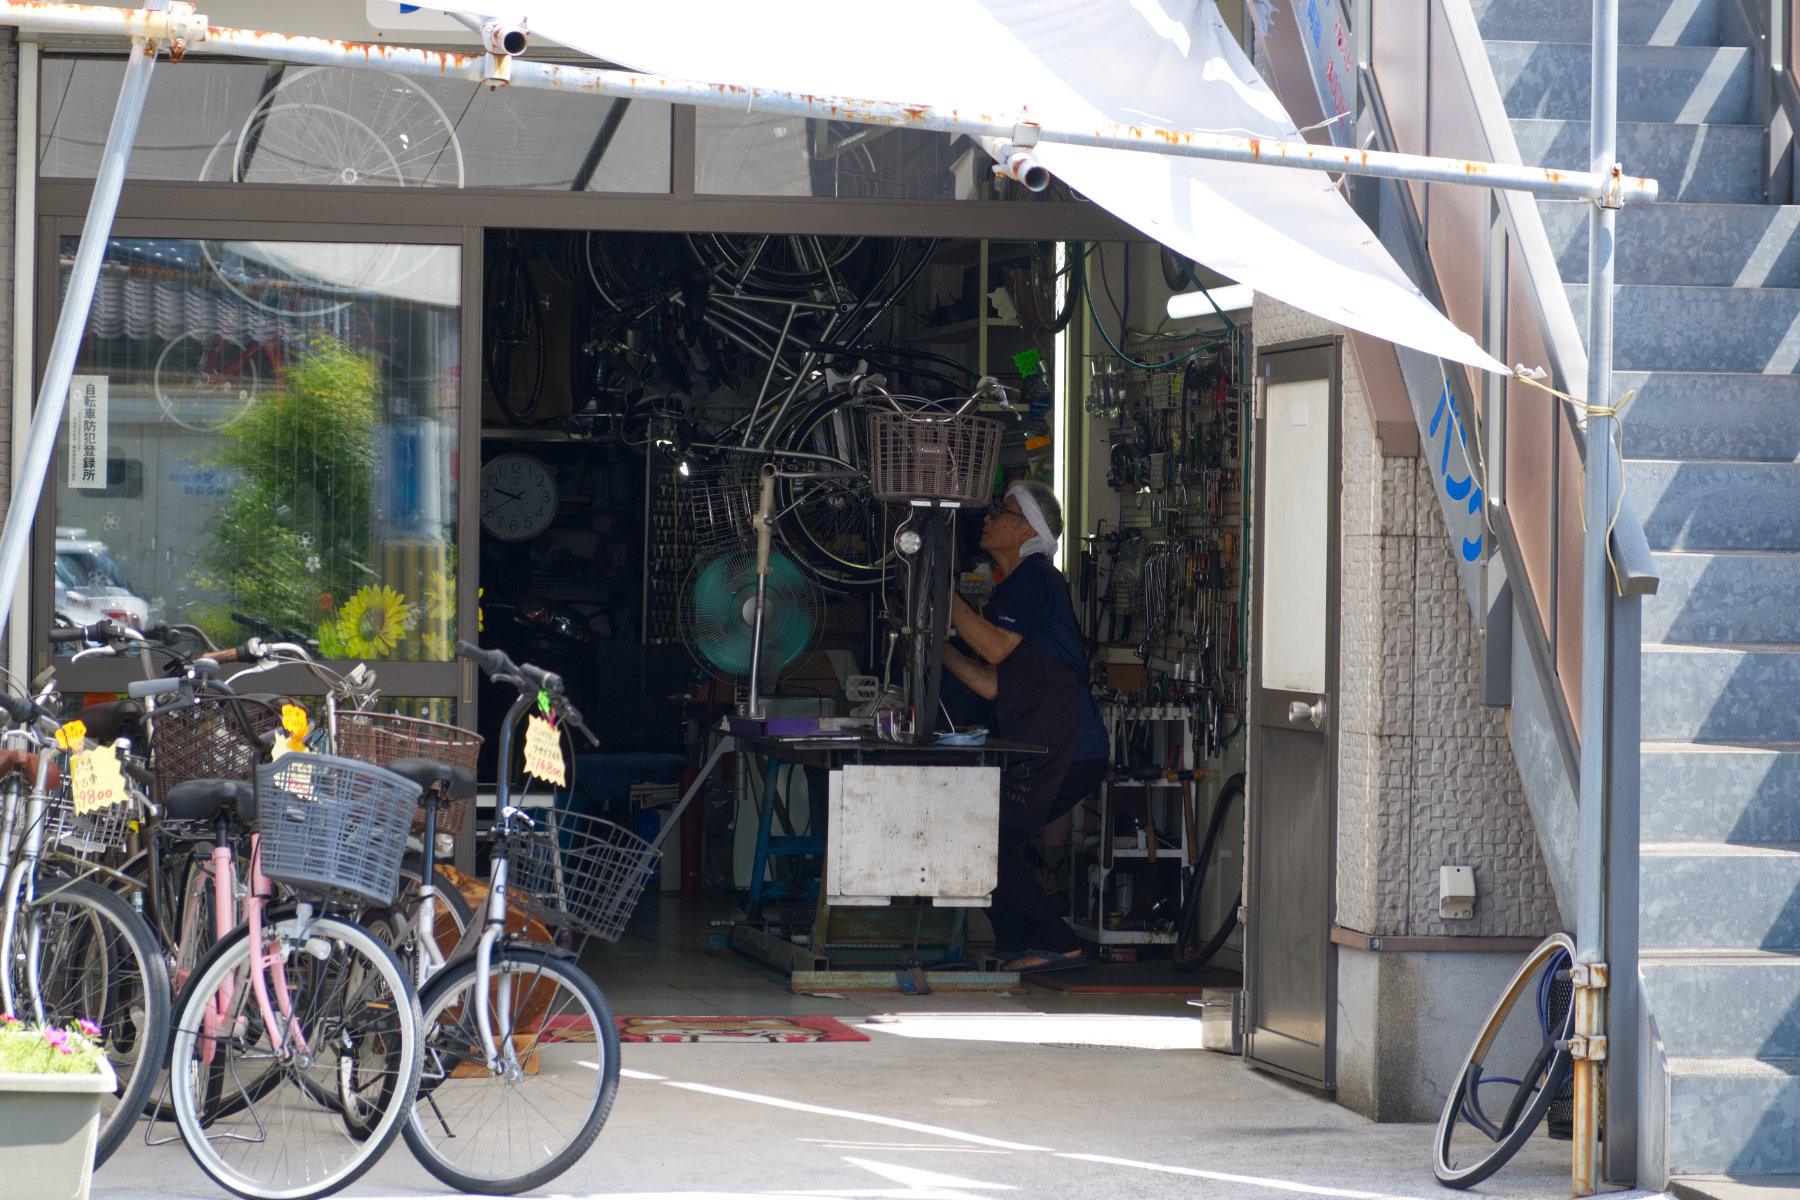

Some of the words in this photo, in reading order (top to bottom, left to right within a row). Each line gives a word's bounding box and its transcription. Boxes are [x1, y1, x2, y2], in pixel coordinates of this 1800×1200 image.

[83, 383, 97, 481] 自転車防犯登録所
[498, 464, 508, 476] 11
[510, 462, 521, 473] 12
[487, 474, 497, 486] 10
[536, 475, 545, 487] 2
[481, 490, 489, 502] 9
[542, 491, 550, 503] 3
[535, 506, 543, 518] 4
[497, 517, 505, 528] 7
[510, 520, 518, 532] 6
[525, 517, 533, 529] 5
[535, 757, 563, 778] 14800
[79, 789, 113, 809] 9800
